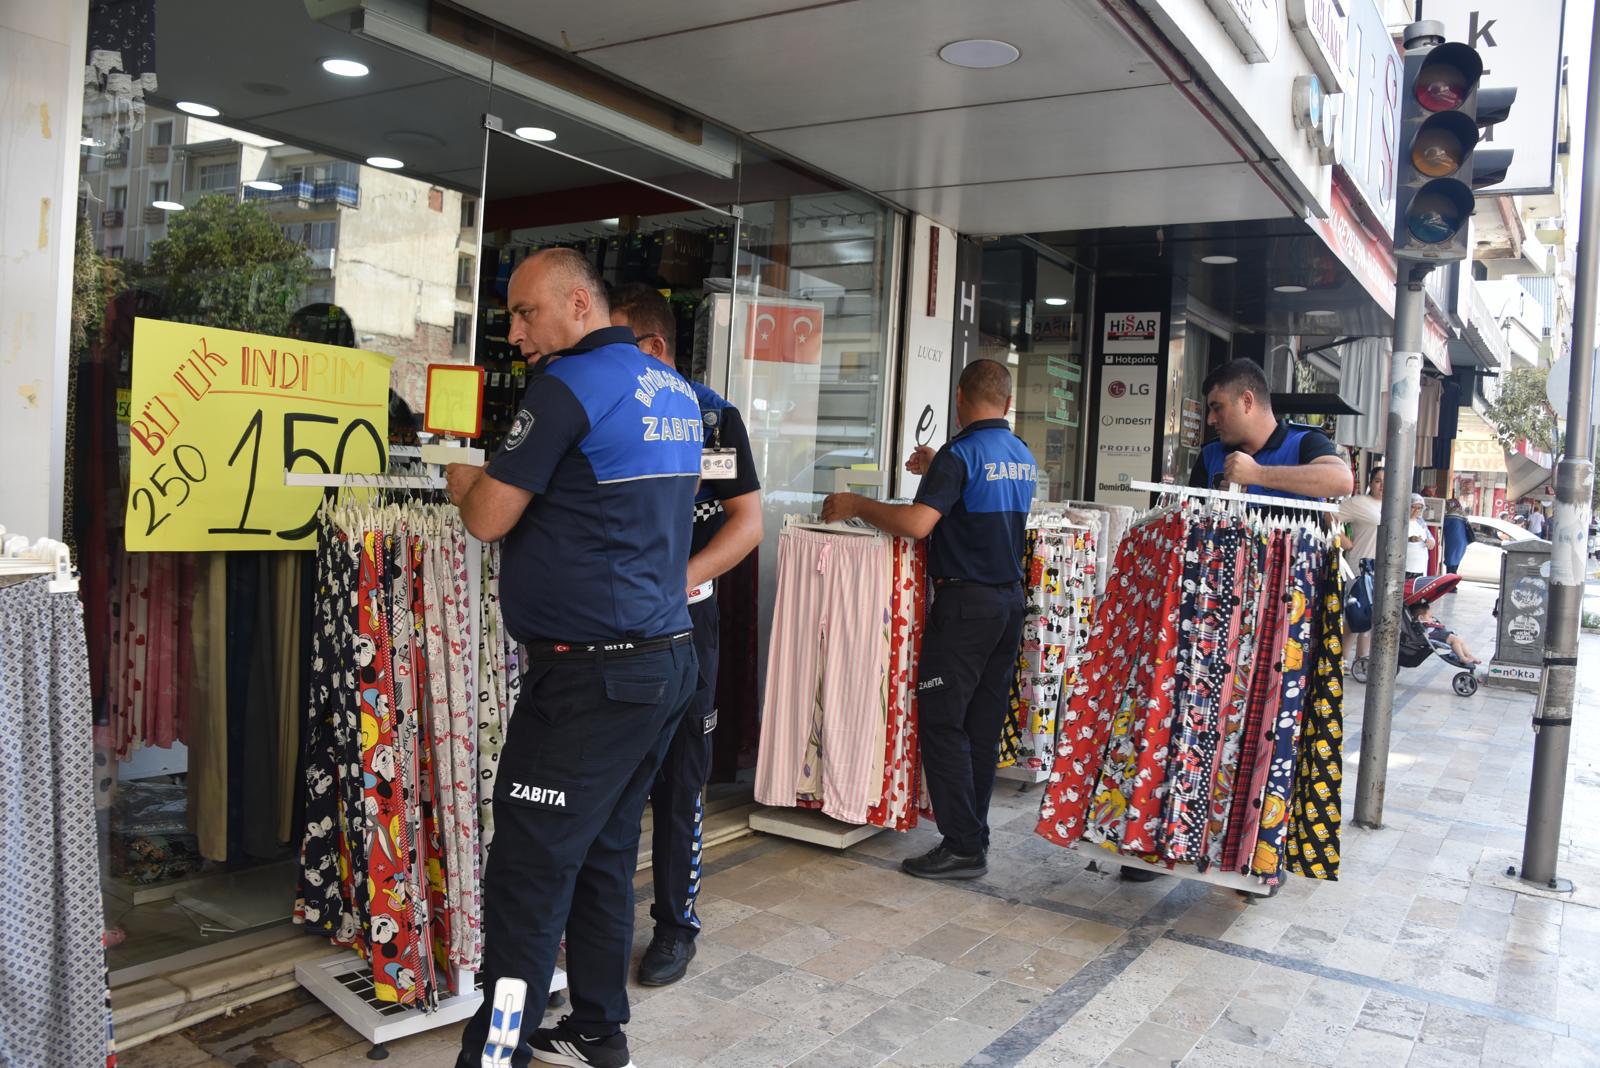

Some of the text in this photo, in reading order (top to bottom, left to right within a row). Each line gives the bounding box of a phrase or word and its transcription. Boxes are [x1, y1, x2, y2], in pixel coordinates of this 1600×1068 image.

[917, 344, 943, 363] LUCKY
[1115, 355, 1157, 365] Hotpoint
[1129, 383, 1150, 396] LG
[984, 462, 1037, 482] ZABITA
[132, 444, 207, 536] 250
[587, 642, 634, 651] ZBITA
[918, 676, 944, 690] ZABITA
[509, 782, 566, 807] ZABITA
